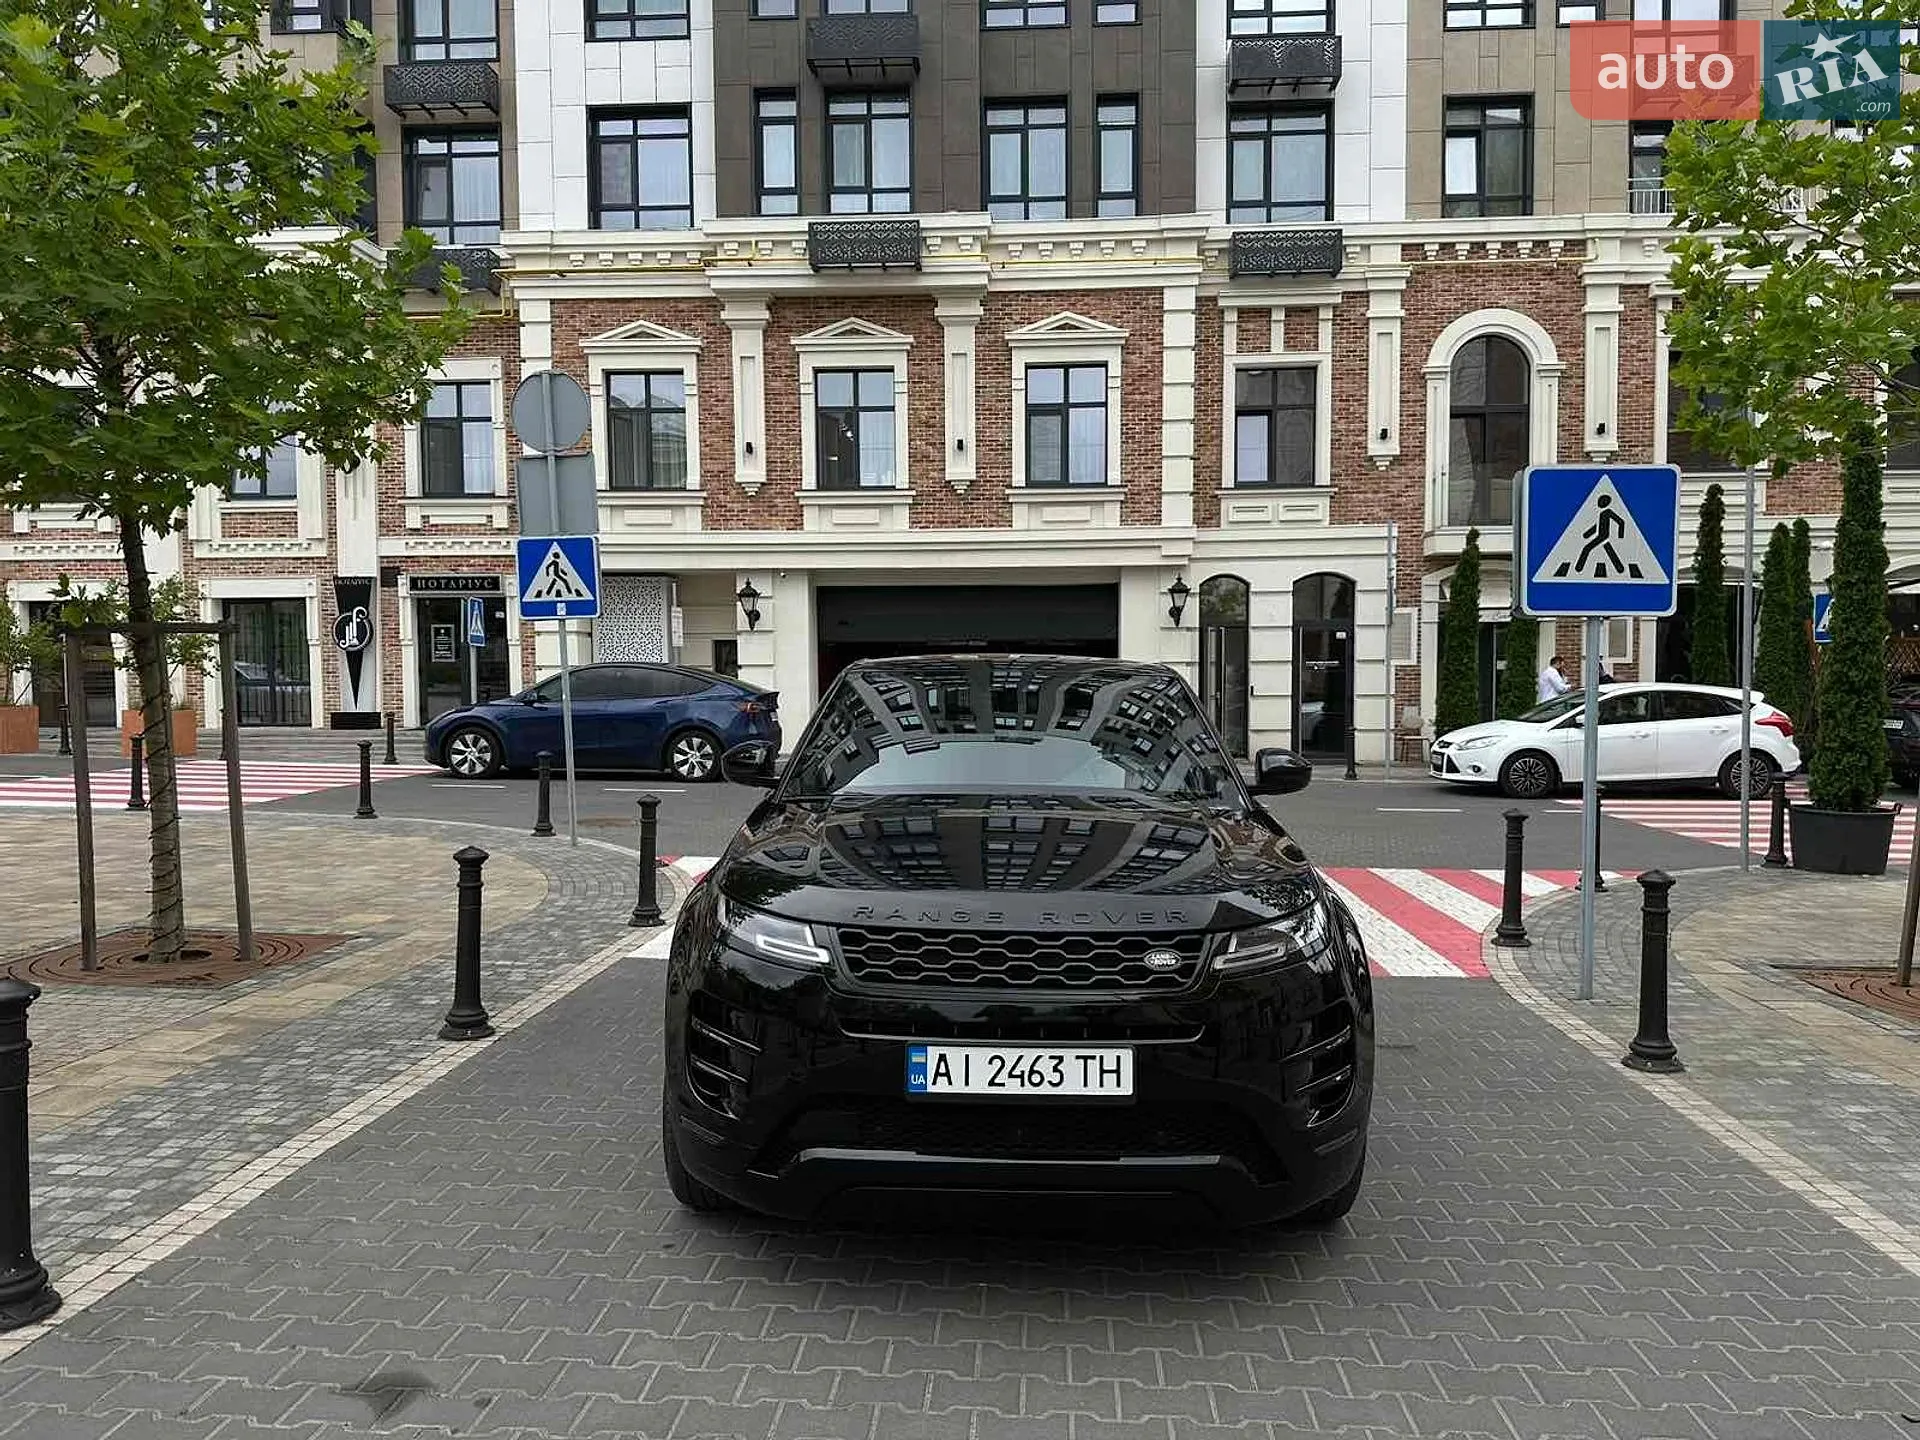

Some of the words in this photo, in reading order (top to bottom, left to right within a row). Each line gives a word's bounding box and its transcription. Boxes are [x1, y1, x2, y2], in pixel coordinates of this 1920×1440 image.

[417, 578, 493, 589] НОТАРІУС
[852, 905, 1005, 925] RANGE
[1039, 910, 1189, 925] ROVER
[931, 1053, 970, 1087] AI
[987, 1054, 1065, 1088] 2463
[1075, 1054, 1121, 1088] TH
[911, 1074, 925, 1085] UA
